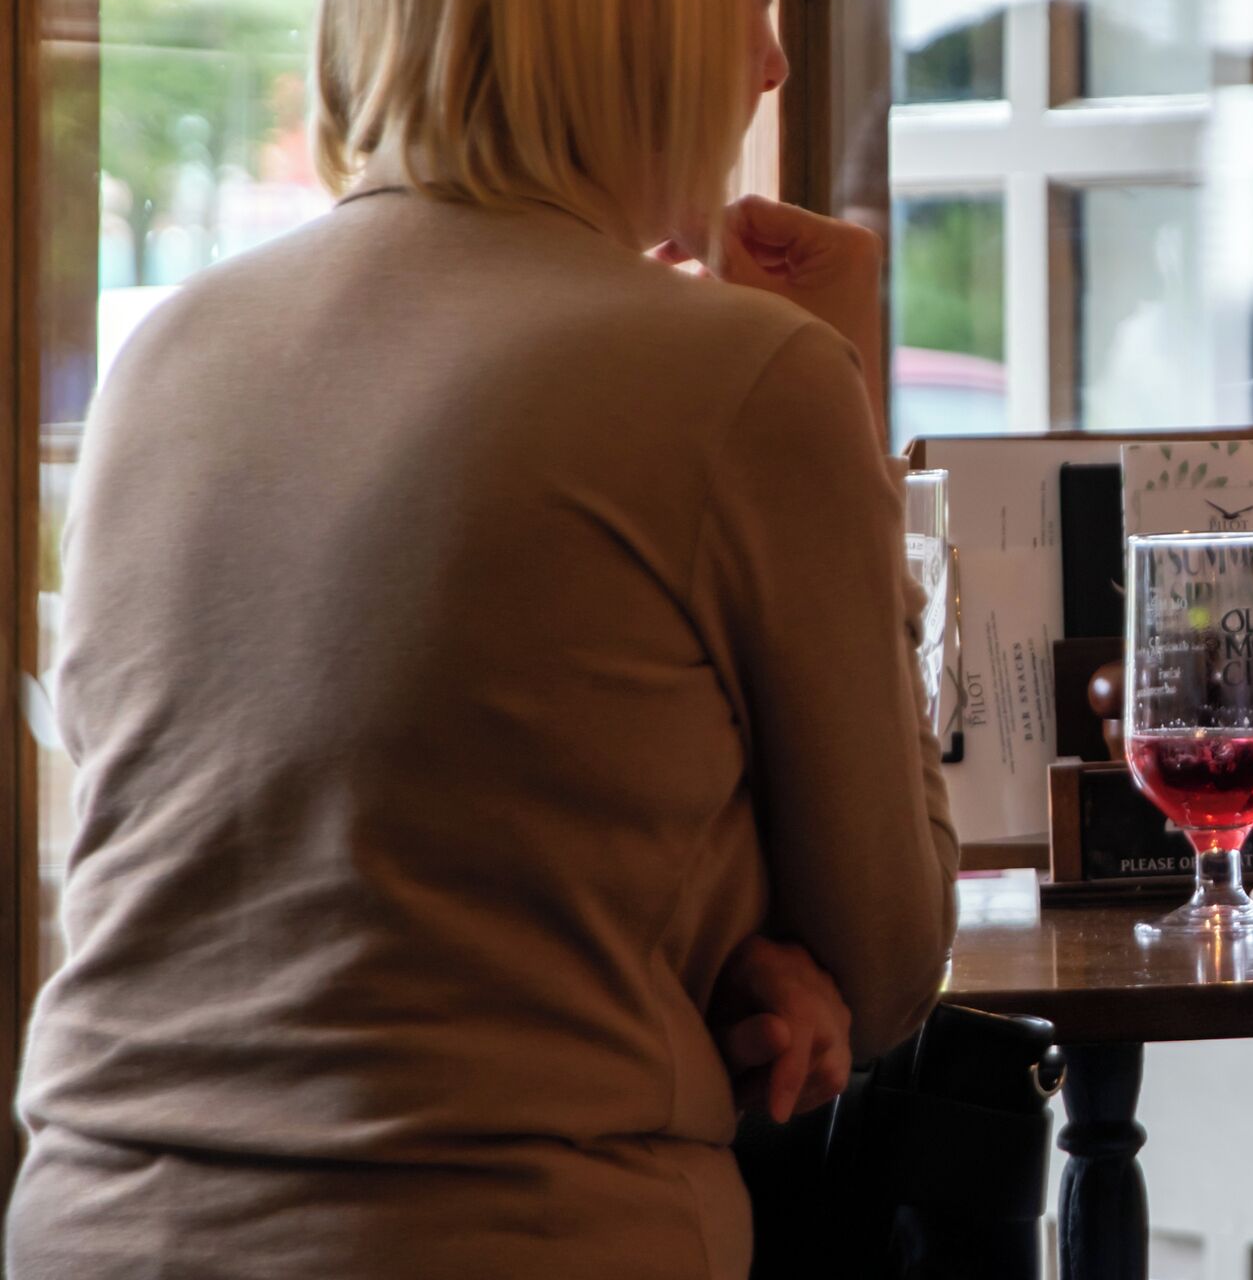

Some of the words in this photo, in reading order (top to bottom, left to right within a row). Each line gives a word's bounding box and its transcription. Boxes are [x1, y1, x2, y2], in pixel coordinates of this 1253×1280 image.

[1012, 642, 1029, 703] SNACKS
[966, 671, 986, 728] PILOT
[1021, 711, 1034, 742] BAR
[1121, 856, 1176, 872] PLEASE
